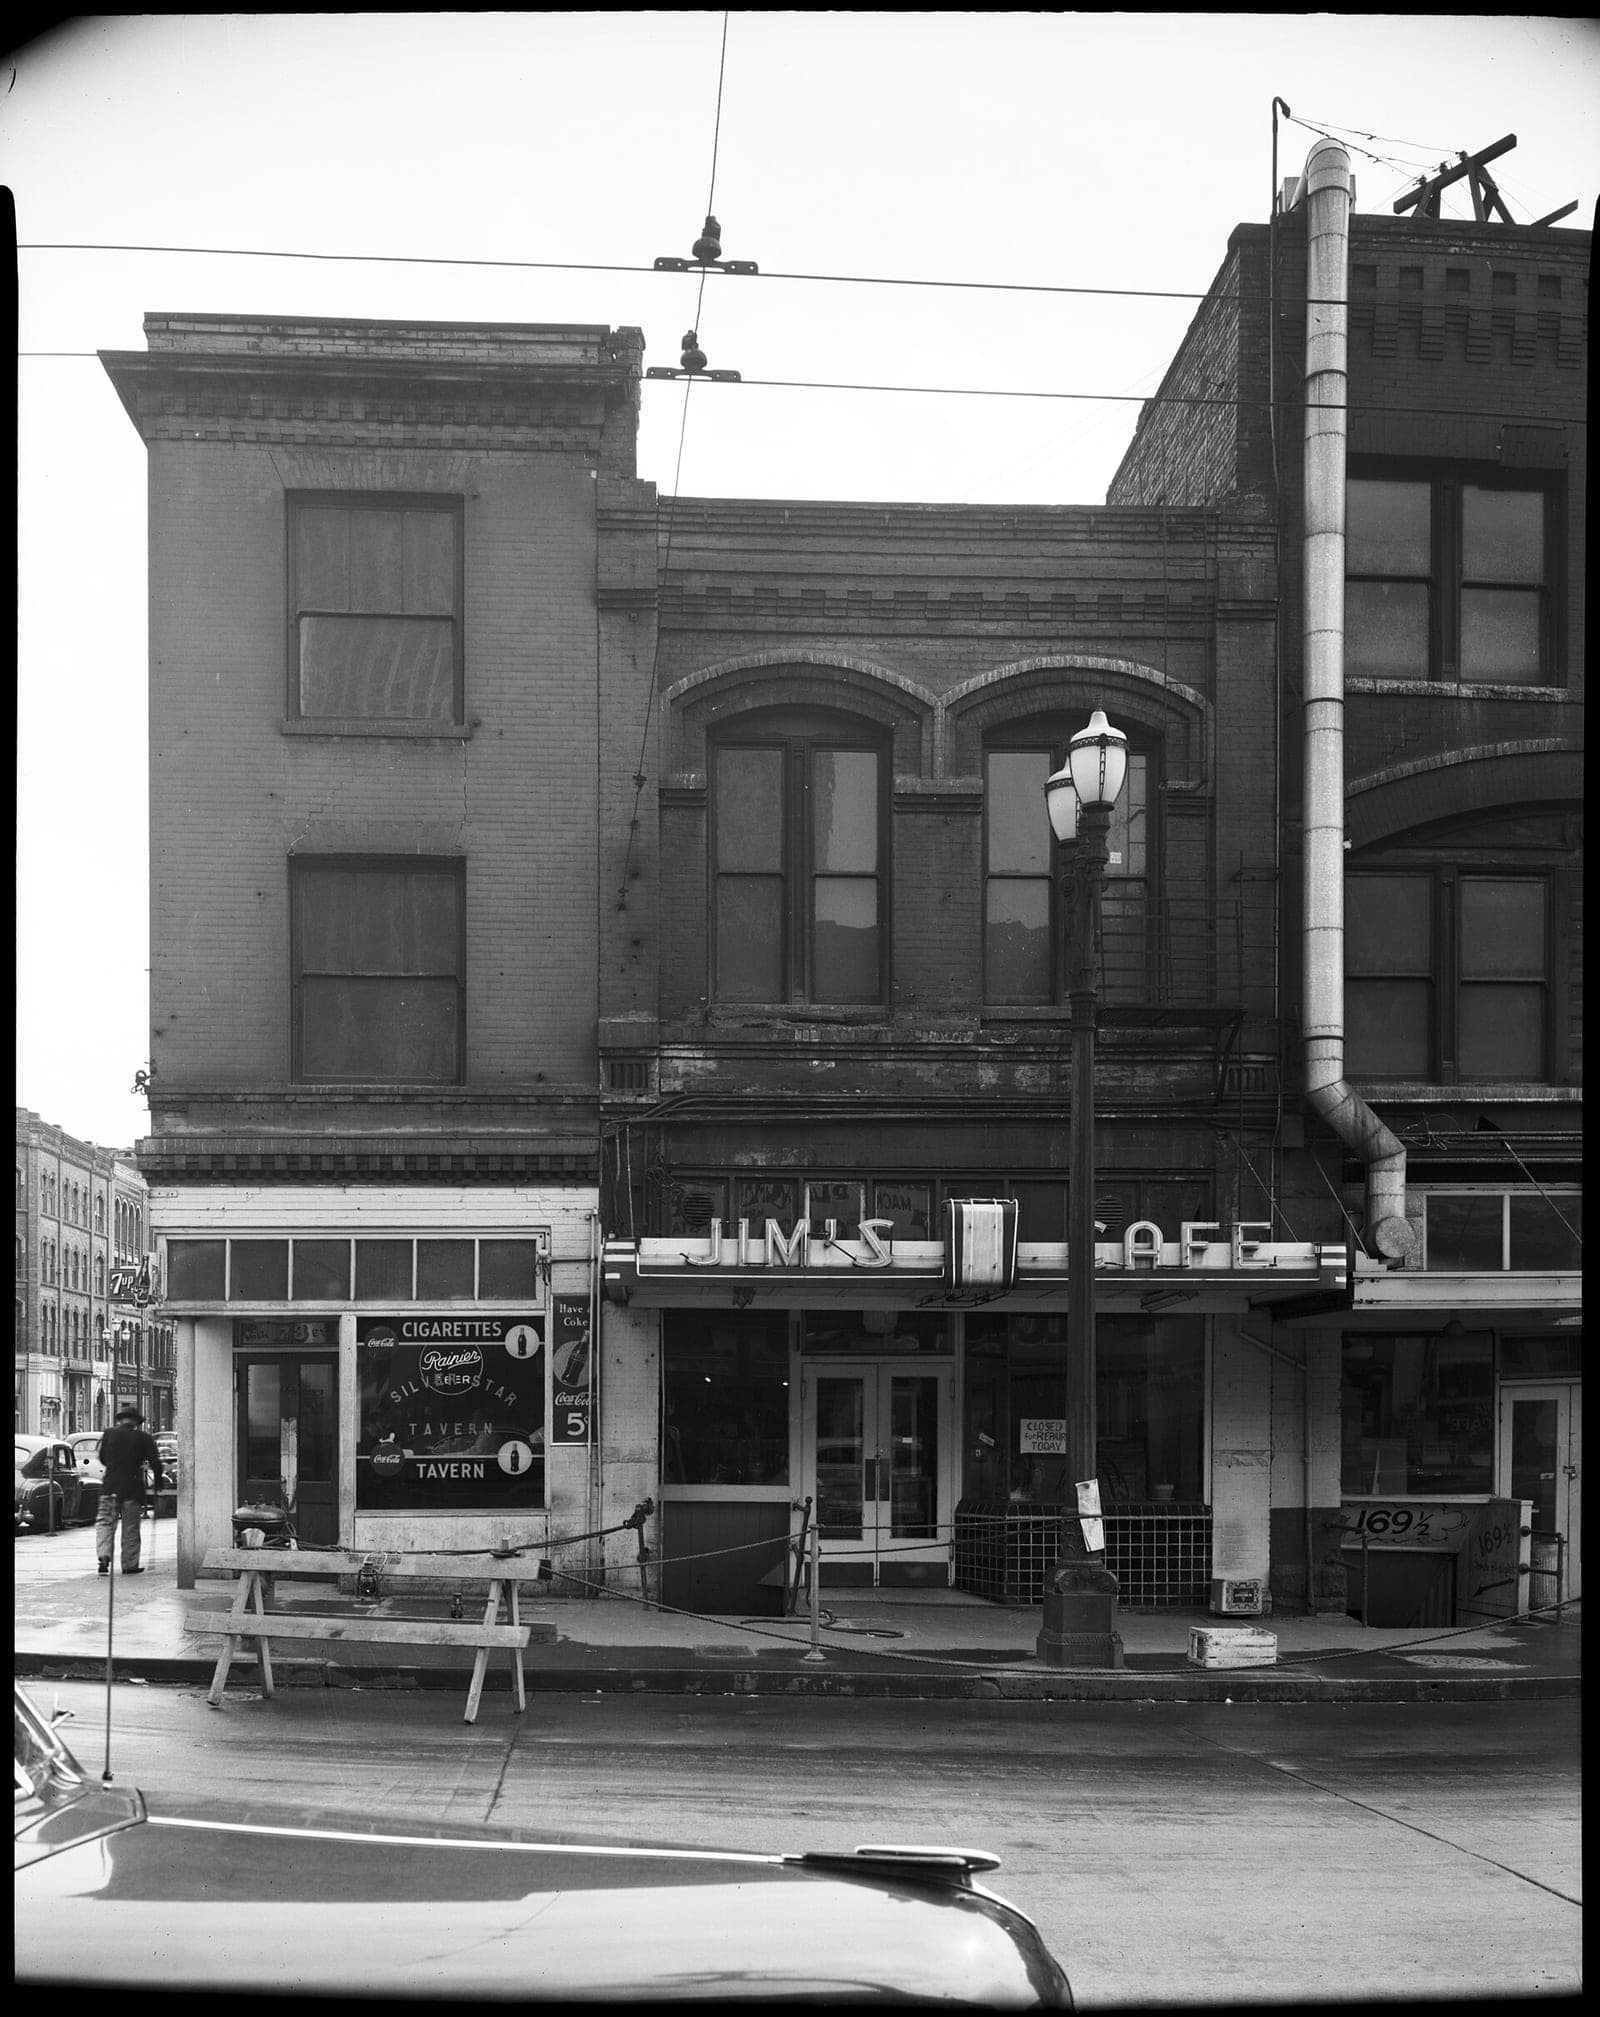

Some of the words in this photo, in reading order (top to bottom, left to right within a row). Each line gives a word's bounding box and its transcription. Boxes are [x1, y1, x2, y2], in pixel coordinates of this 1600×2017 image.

[685, 1217, 894, 1268] JIM'S
[559, 1303, 584, 1313] Have
[563, 1316, 589, 1327] Coke
[402, 1321, 501, 1337] CIGARETTES
[422, 1349, 481, 1371] Rainier
[390, 1373, 457, 1403] SILVER
[471, 1375, 518, 1407] STAR
[409, 1423, 492, 1436] TAVERN
[1027, 1422, 1063, 1431] CLOSED
[1031, 1441, 1062, 1451] TODAY
[416, 1463, 485, 1479] TAVERN
